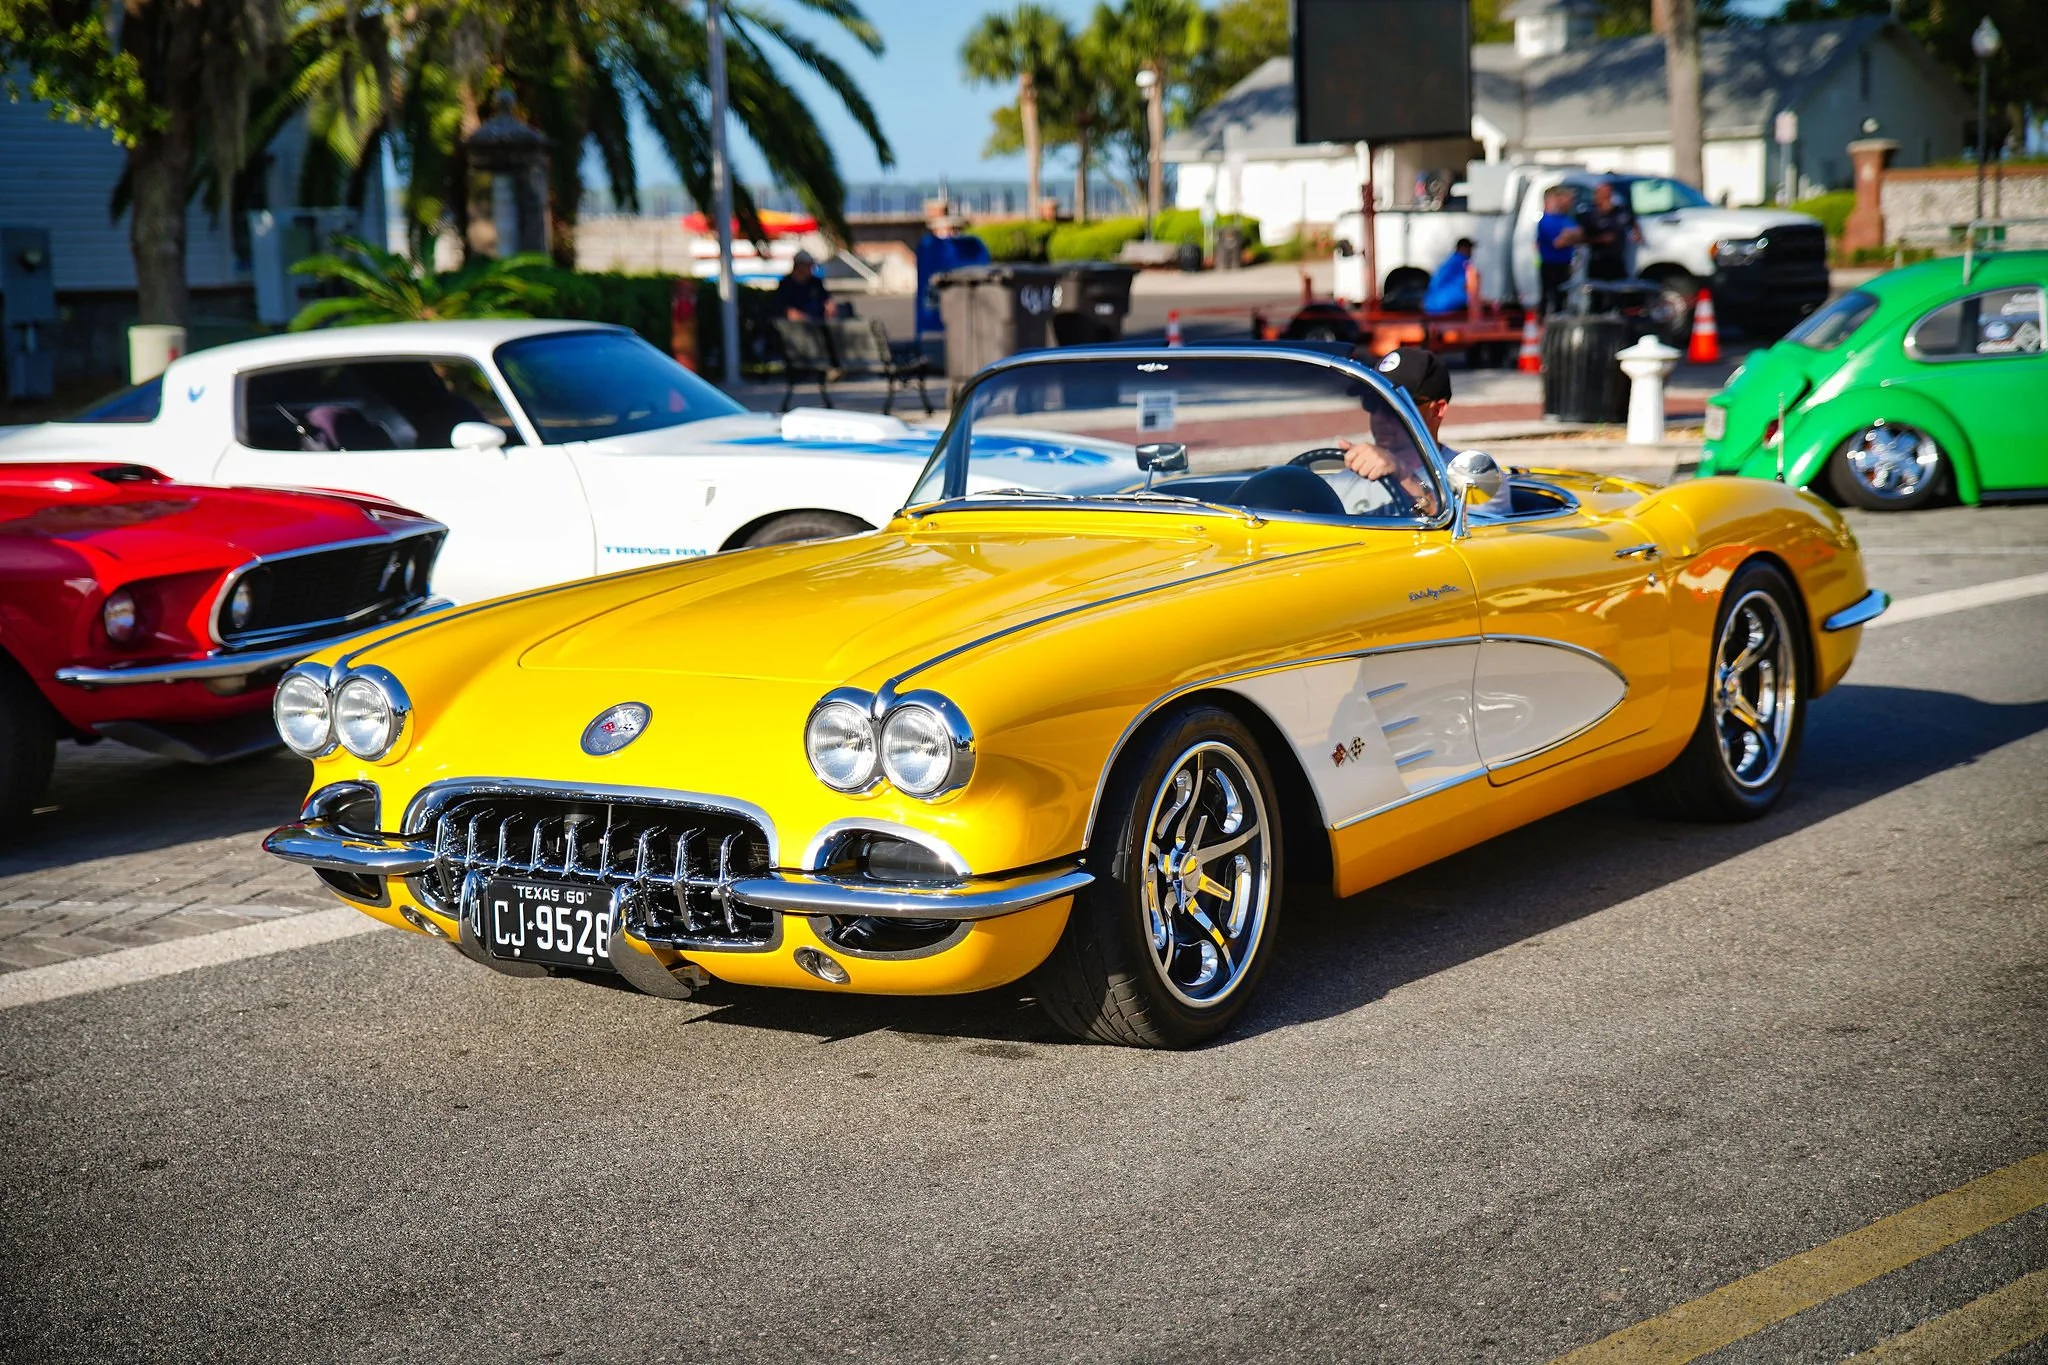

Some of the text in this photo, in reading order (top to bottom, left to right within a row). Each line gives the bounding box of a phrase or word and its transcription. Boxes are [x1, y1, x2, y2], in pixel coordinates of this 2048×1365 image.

[604, 545, 707, 557] TRANS AM
[516, 884, 586, 905] TEXAS 60
